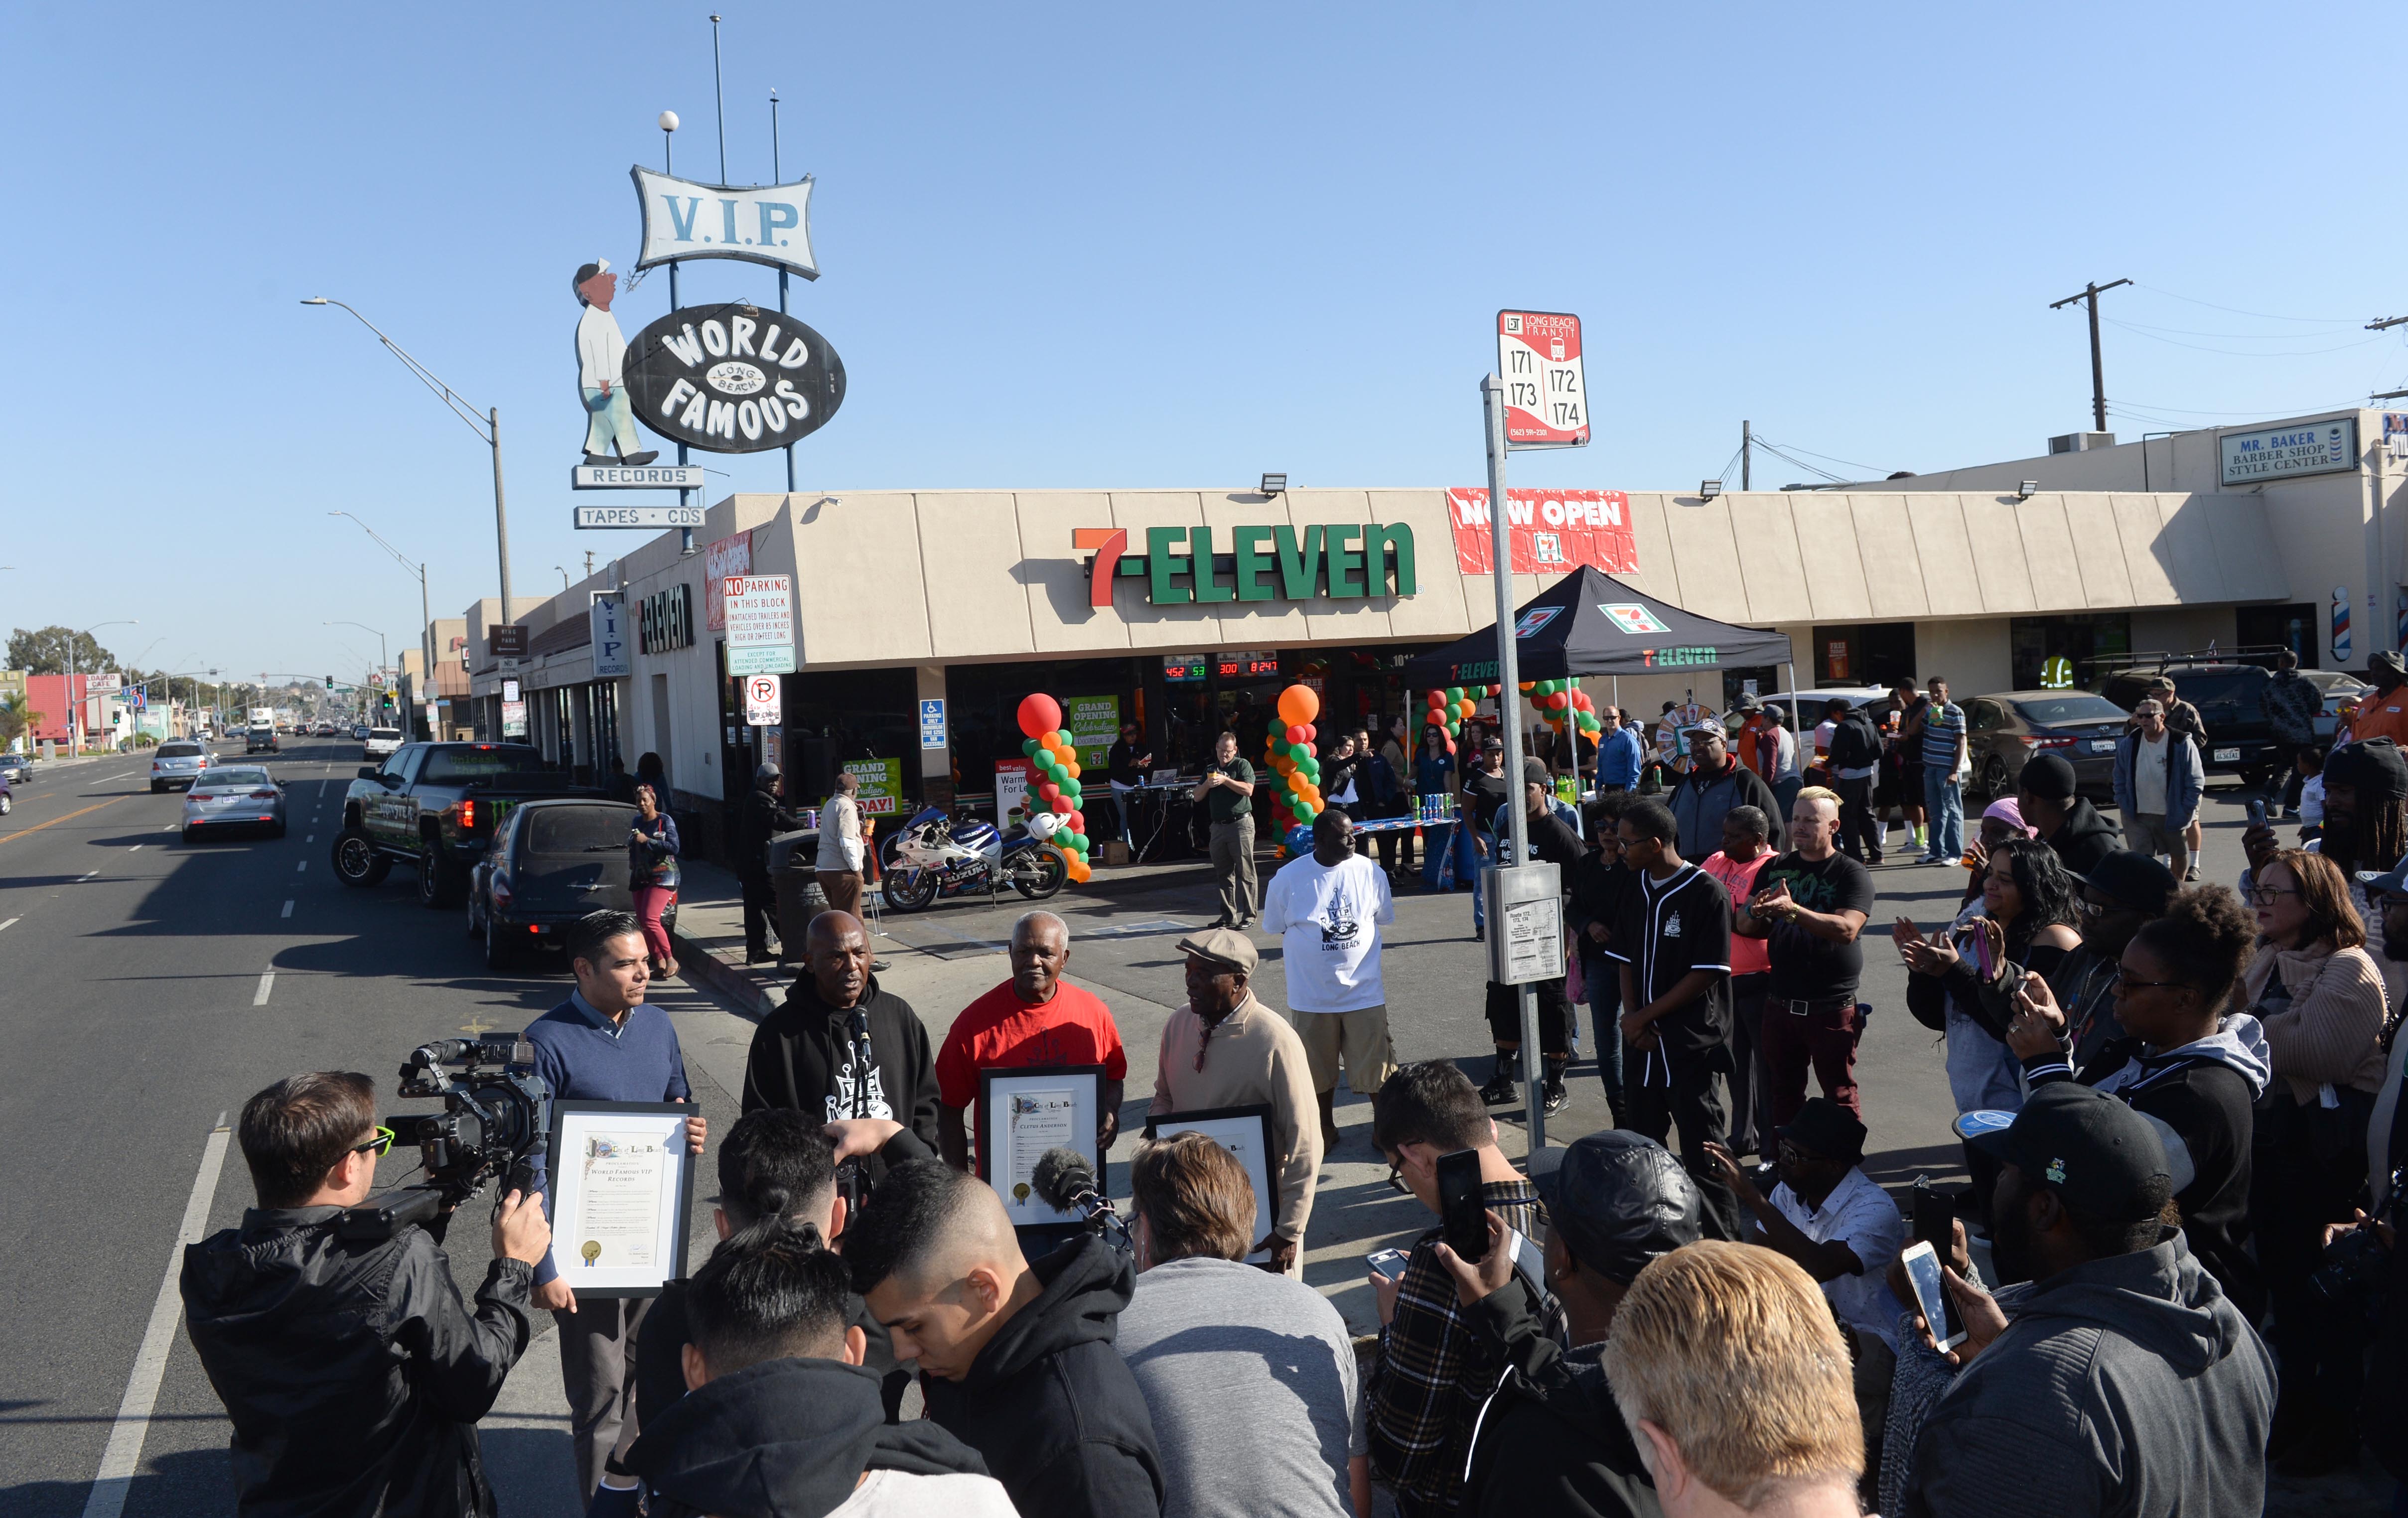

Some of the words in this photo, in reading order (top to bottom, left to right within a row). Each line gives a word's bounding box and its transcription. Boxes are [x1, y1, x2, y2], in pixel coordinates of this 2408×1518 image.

[660, 195, 799, 247] V.I.P.
[1525, 315, 1548, 327] LONG
[1550, 316, 1575, 328] BEACH
[1526, 326, 1575, 338] TRANSIT
[662, 315, 809, 370] WORLD
[1552, 346, 1564, 356] BUS
[1511, 350, 1532, 374] 171
[717, 366, 756, 379] LONG
[718, 379, 757, 392] BEACH
[1550, 369, 1576, 392] 172
[1510, 383, 1537, 407] 173
[661, 378, 810, 440] FAMOUS
[1553, 402, 1579, 425] 174
[1510, 428, 1525, 436] (562)
[1525, 428, 1548, 437] 591-2301
[2240, 439, 2264, 453] MR.
[2271, 431, 2316, 449] BAKER
[2234, 449, 2283, 465] BARBER
[2288, 444, 2325, 457] SHOP
[2229, 462, 2269, 476] STYLE
[2274, 455, 2329, 470] CENTER
[593, 468, 687, 483] RECORDS
[583, 510, 639, 524] TAPES
[668, 507, 701, 524] CD'S
[1459, 499, 1534, 525] NW
[1542, 499, 1622, 526] OPEN
[725, 579, 742, 595] NO
[745, 579, 788, 592] PARKING
[730, 600, 738, 609] IN
[741, 599, 758, 608] THIS
[761, 598, 785, 608] BLOCK
[728, 613, 757, 622] UNATTACHED
[758, 612, 779, 620] TRAILERS
[730, 623, 751, 632] VEHICLES
[753, 622, 765, 631] OVER
[599, 664, 629, 674] RECORDS
[1166, 667, 1185, 677] 452
[1193, 667, 1205, 676] 53
[1220, 664, 1238, 674] 300
[1251, 662, 1258, 672] 8
[1259, 661, 1277, 672] 247
[1077, 702, 1112, 711] GRAND
[1074, 711, 1117, 721] OPENING
[1073, 720, 1117, 733] Celebration
[450, 754, 500, 765] Unleash
[843, 762, 885, 773] GRAND
[856, 773, 887, 783] NING
[859, 797, 893, 813] DAY!
[958, 831, 979, 839] SUZUKI
[944, 863, 989, 883] SUZUKI
[1341, 940, 1360, 950] BEACH
